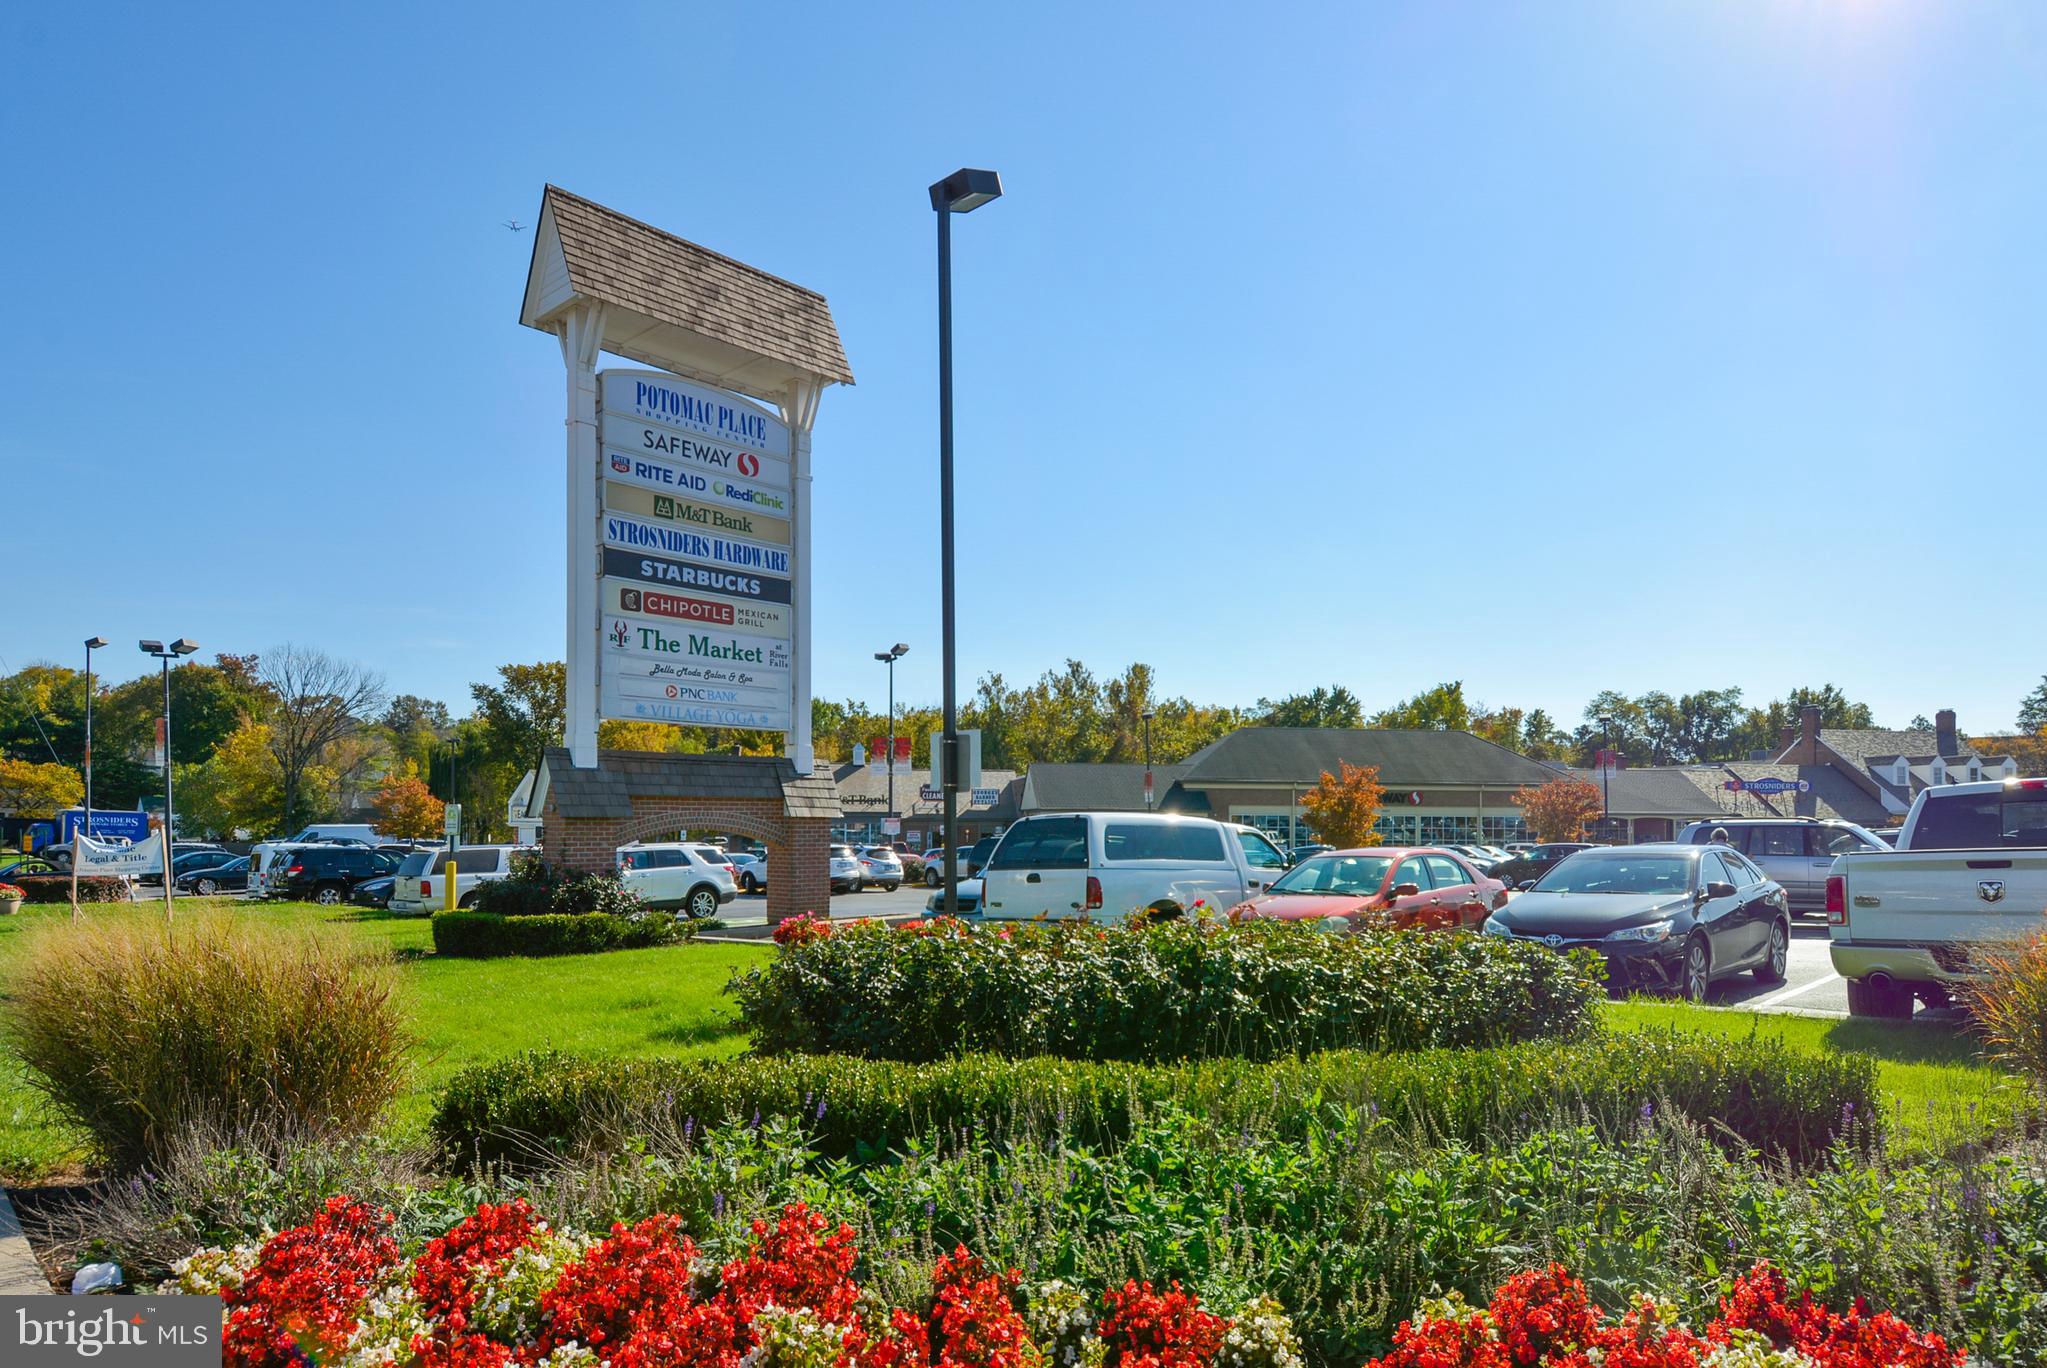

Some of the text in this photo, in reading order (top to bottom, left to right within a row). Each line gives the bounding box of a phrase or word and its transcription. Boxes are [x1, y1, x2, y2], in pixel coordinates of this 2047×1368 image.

[636, 381, 766, 441] POTOMAC PLACE
[636, 408, 765, 448] SHOPPING CENTER
[613, 455, 628, 464] RITE
[643, 430, 731, 468] SAFEWAY
[614, 463, 628, 472] AID
[635, 462, 706, 491] RITE AID
[726, 484, 784, 510] RediClinic
[676, 503, 752, 533] M&T Bank
[608, 518, 788, 572] STROSNIDERS HARDWARE
[641, 560, 761, 595] STARBUCKS
[647, 596, 731, 621] CHIPOTLE
[738, 608, 779, 621] MEXICAN
[738, 617, 764, 628] GRILL
[637, 627, 763, 663] The Market
[769, 650, 788, 660] River
[649, 663, 753, 685] Bella Moda Salon & Spa
[769, 658, 788, 669] Falls
[680, 687, 737, 702] PNC BANK
[651, 704, 756, 725] VILLAGE YOGA
[922, 792, 944, 800] CLEANE
[1744, 782, 1796, 790] STROSNIDERS
[839, 794, 889, 807] &T Bank
[84, 854, 148, 864] Legal & Title
